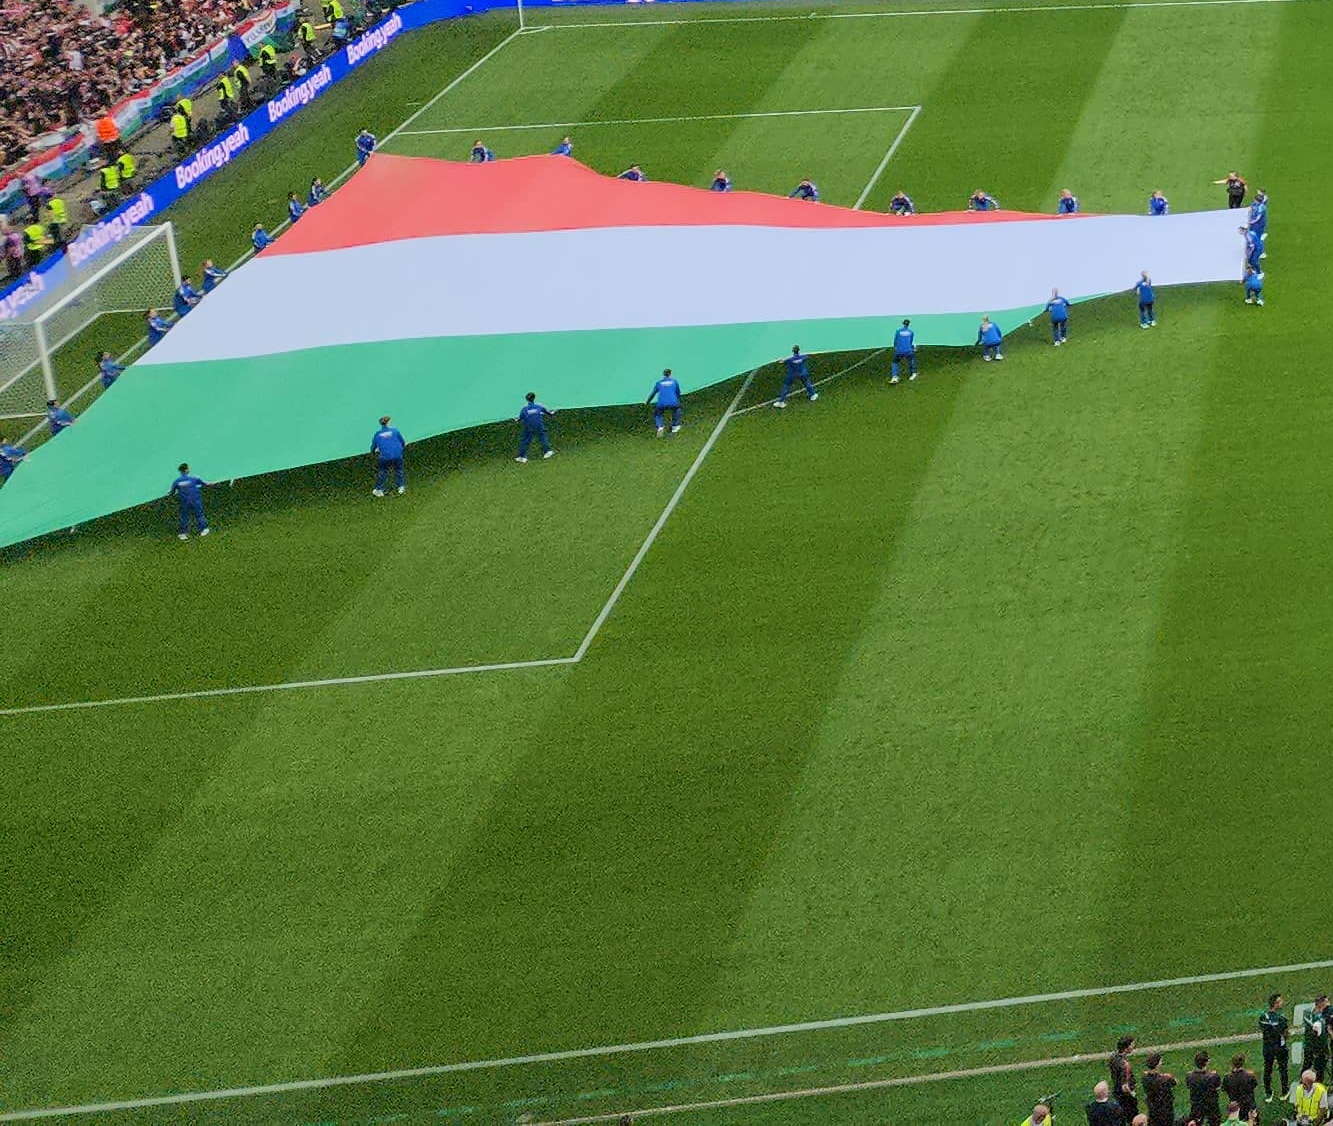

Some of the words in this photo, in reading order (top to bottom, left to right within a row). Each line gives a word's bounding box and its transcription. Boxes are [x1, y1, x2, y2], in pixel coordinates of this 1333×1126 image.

[346, 12, 402, 65] Booking.yeah
[267, 66, 332, 122] Booking.yeah
[175, 123, 249, 188] Booking.yeah
